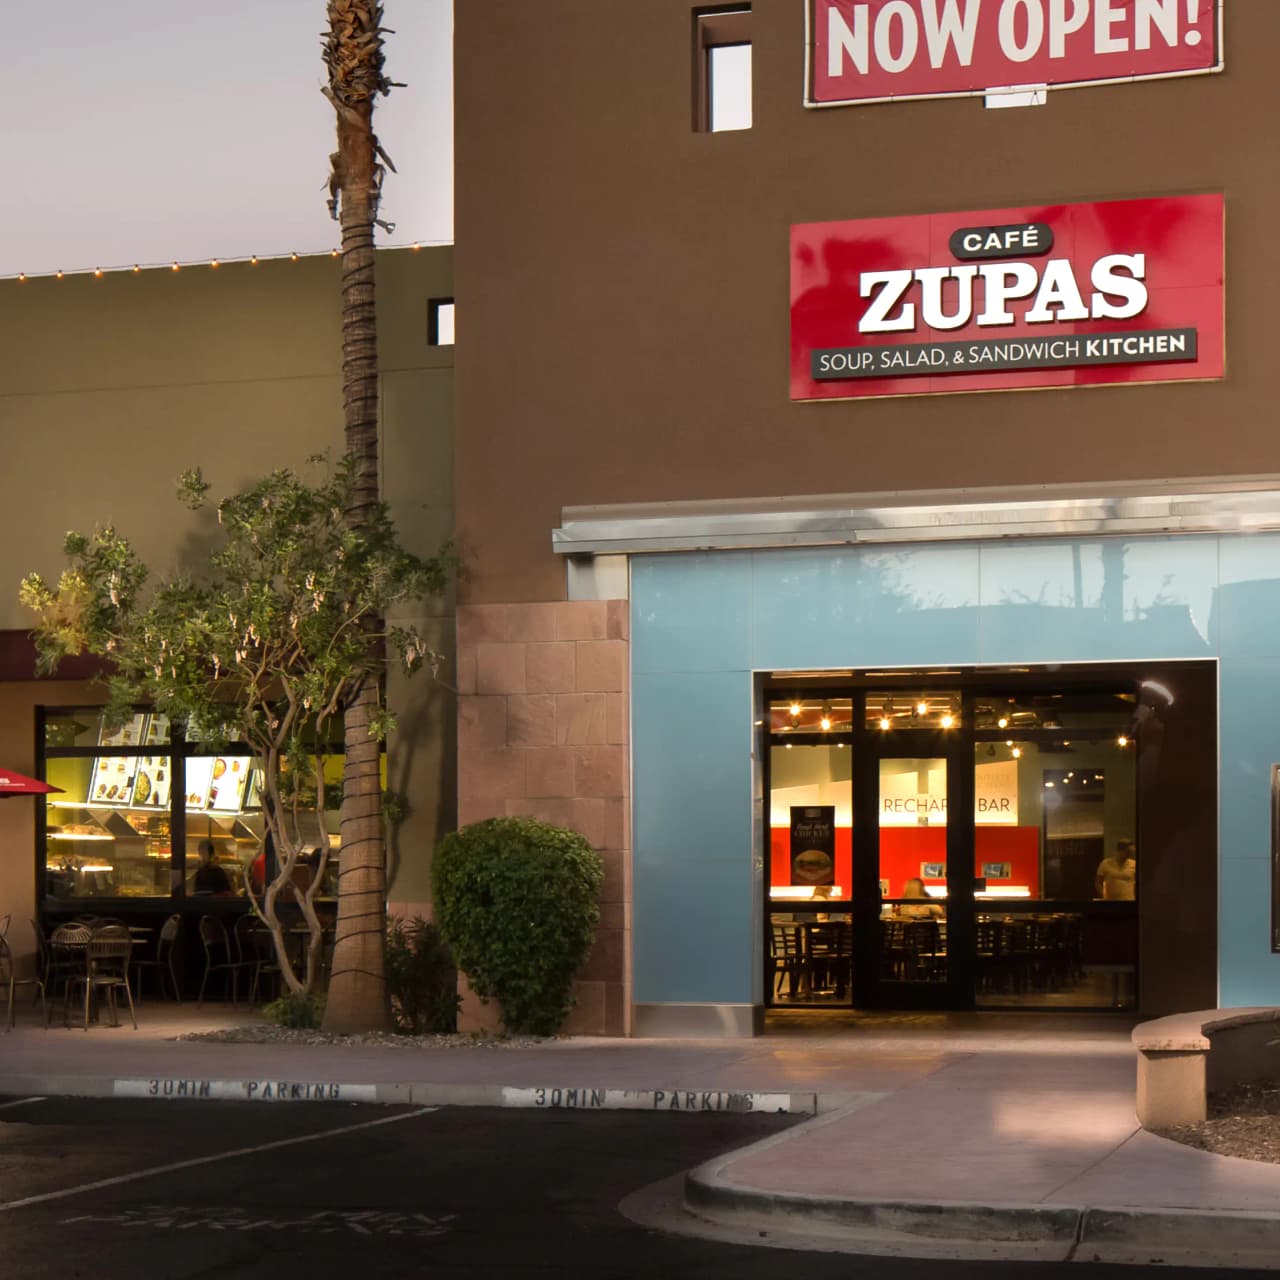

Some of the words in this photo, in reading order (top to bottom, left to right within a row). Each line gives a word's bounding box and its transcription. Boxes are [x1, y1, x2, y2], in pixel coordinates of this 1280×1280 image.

[962, 225, 1039, 252] CAFÉ
[857, 253, 1148, 333] ZUPAS
[819, 353, 875, 372] SOUP,
[880, 349, 949, 368] SALAD,
[952, 352, 964, 364] &
[969, 340, 1079, 364] SANDWICH
[1086, 334, 1185, 357] KITCHEN
[978, 798, 1010, 812] BAR
[247, 1080, 341, 1099] PARKING
